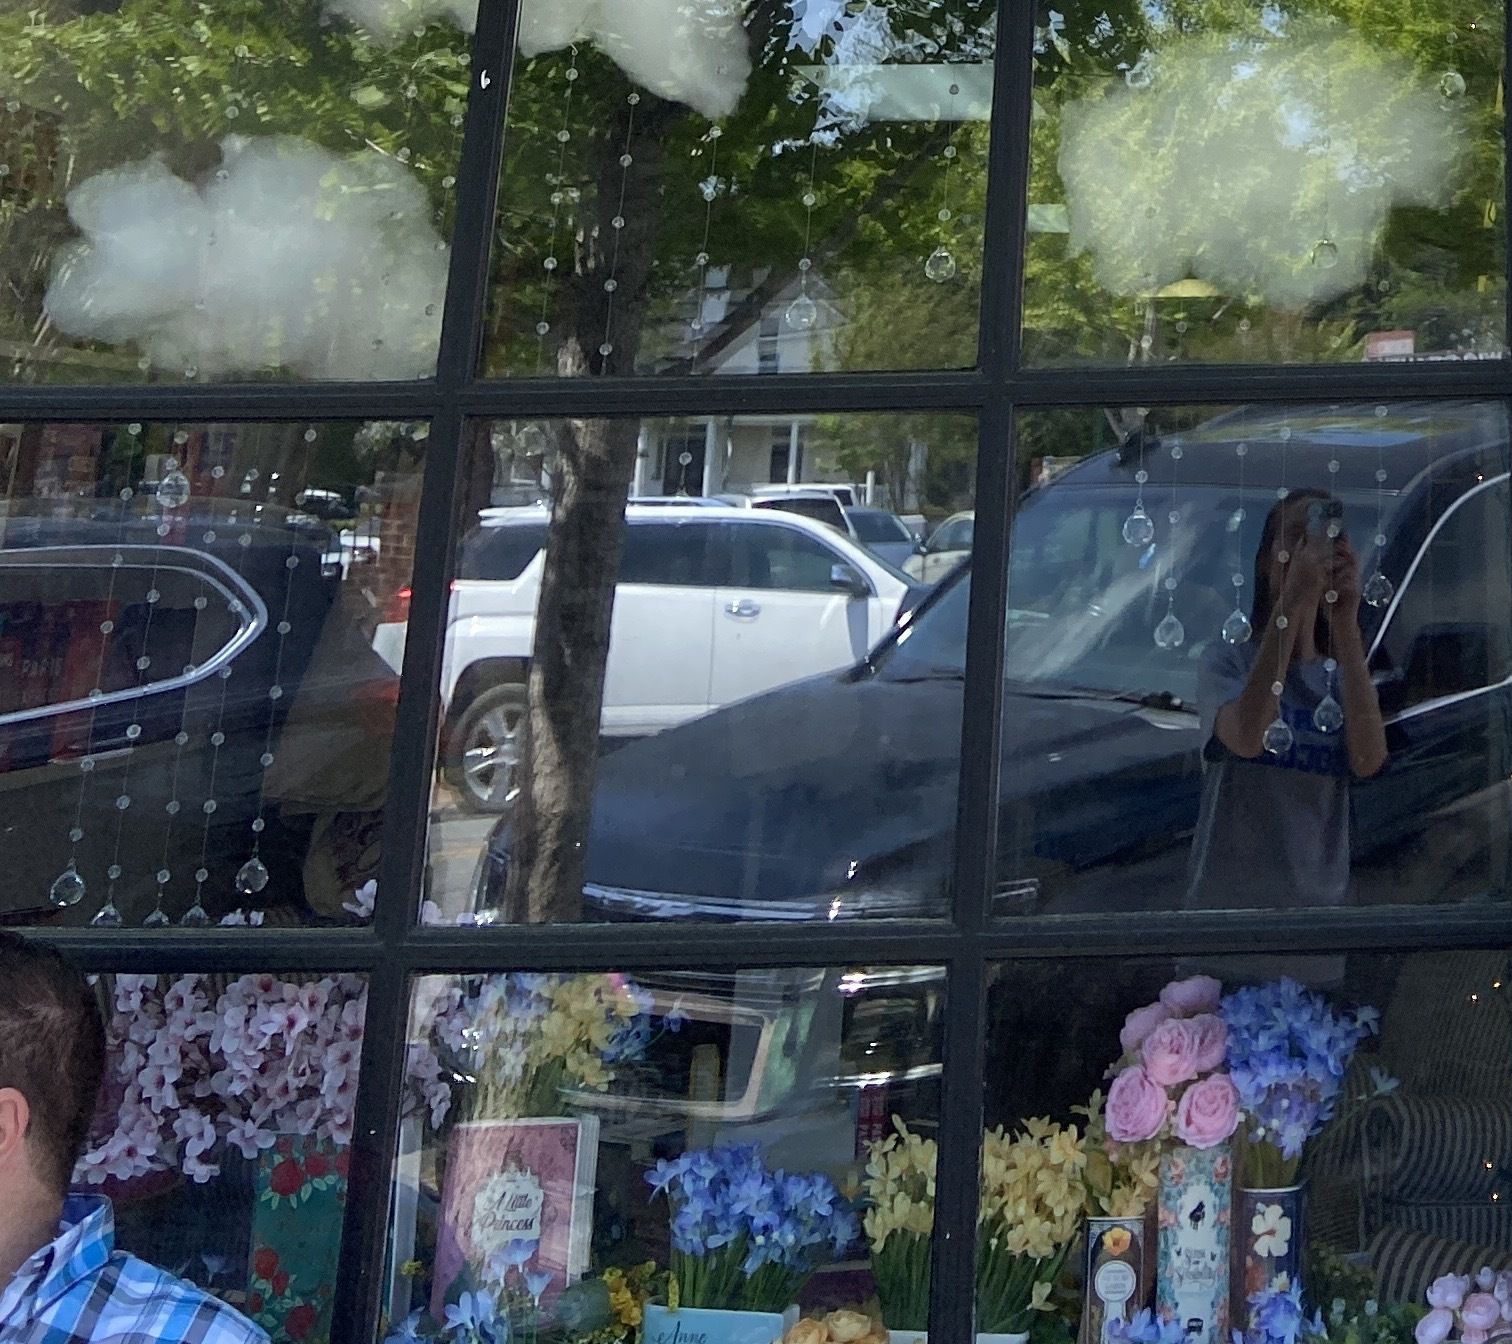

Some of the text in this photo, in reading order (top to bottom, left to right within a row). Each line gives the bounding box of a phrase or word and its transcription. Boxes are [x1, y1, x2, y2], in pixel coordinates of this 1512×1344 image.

[480, 1191, 537, 1232] A Little Princess
[653, 1320, 708, 1344] Anne
